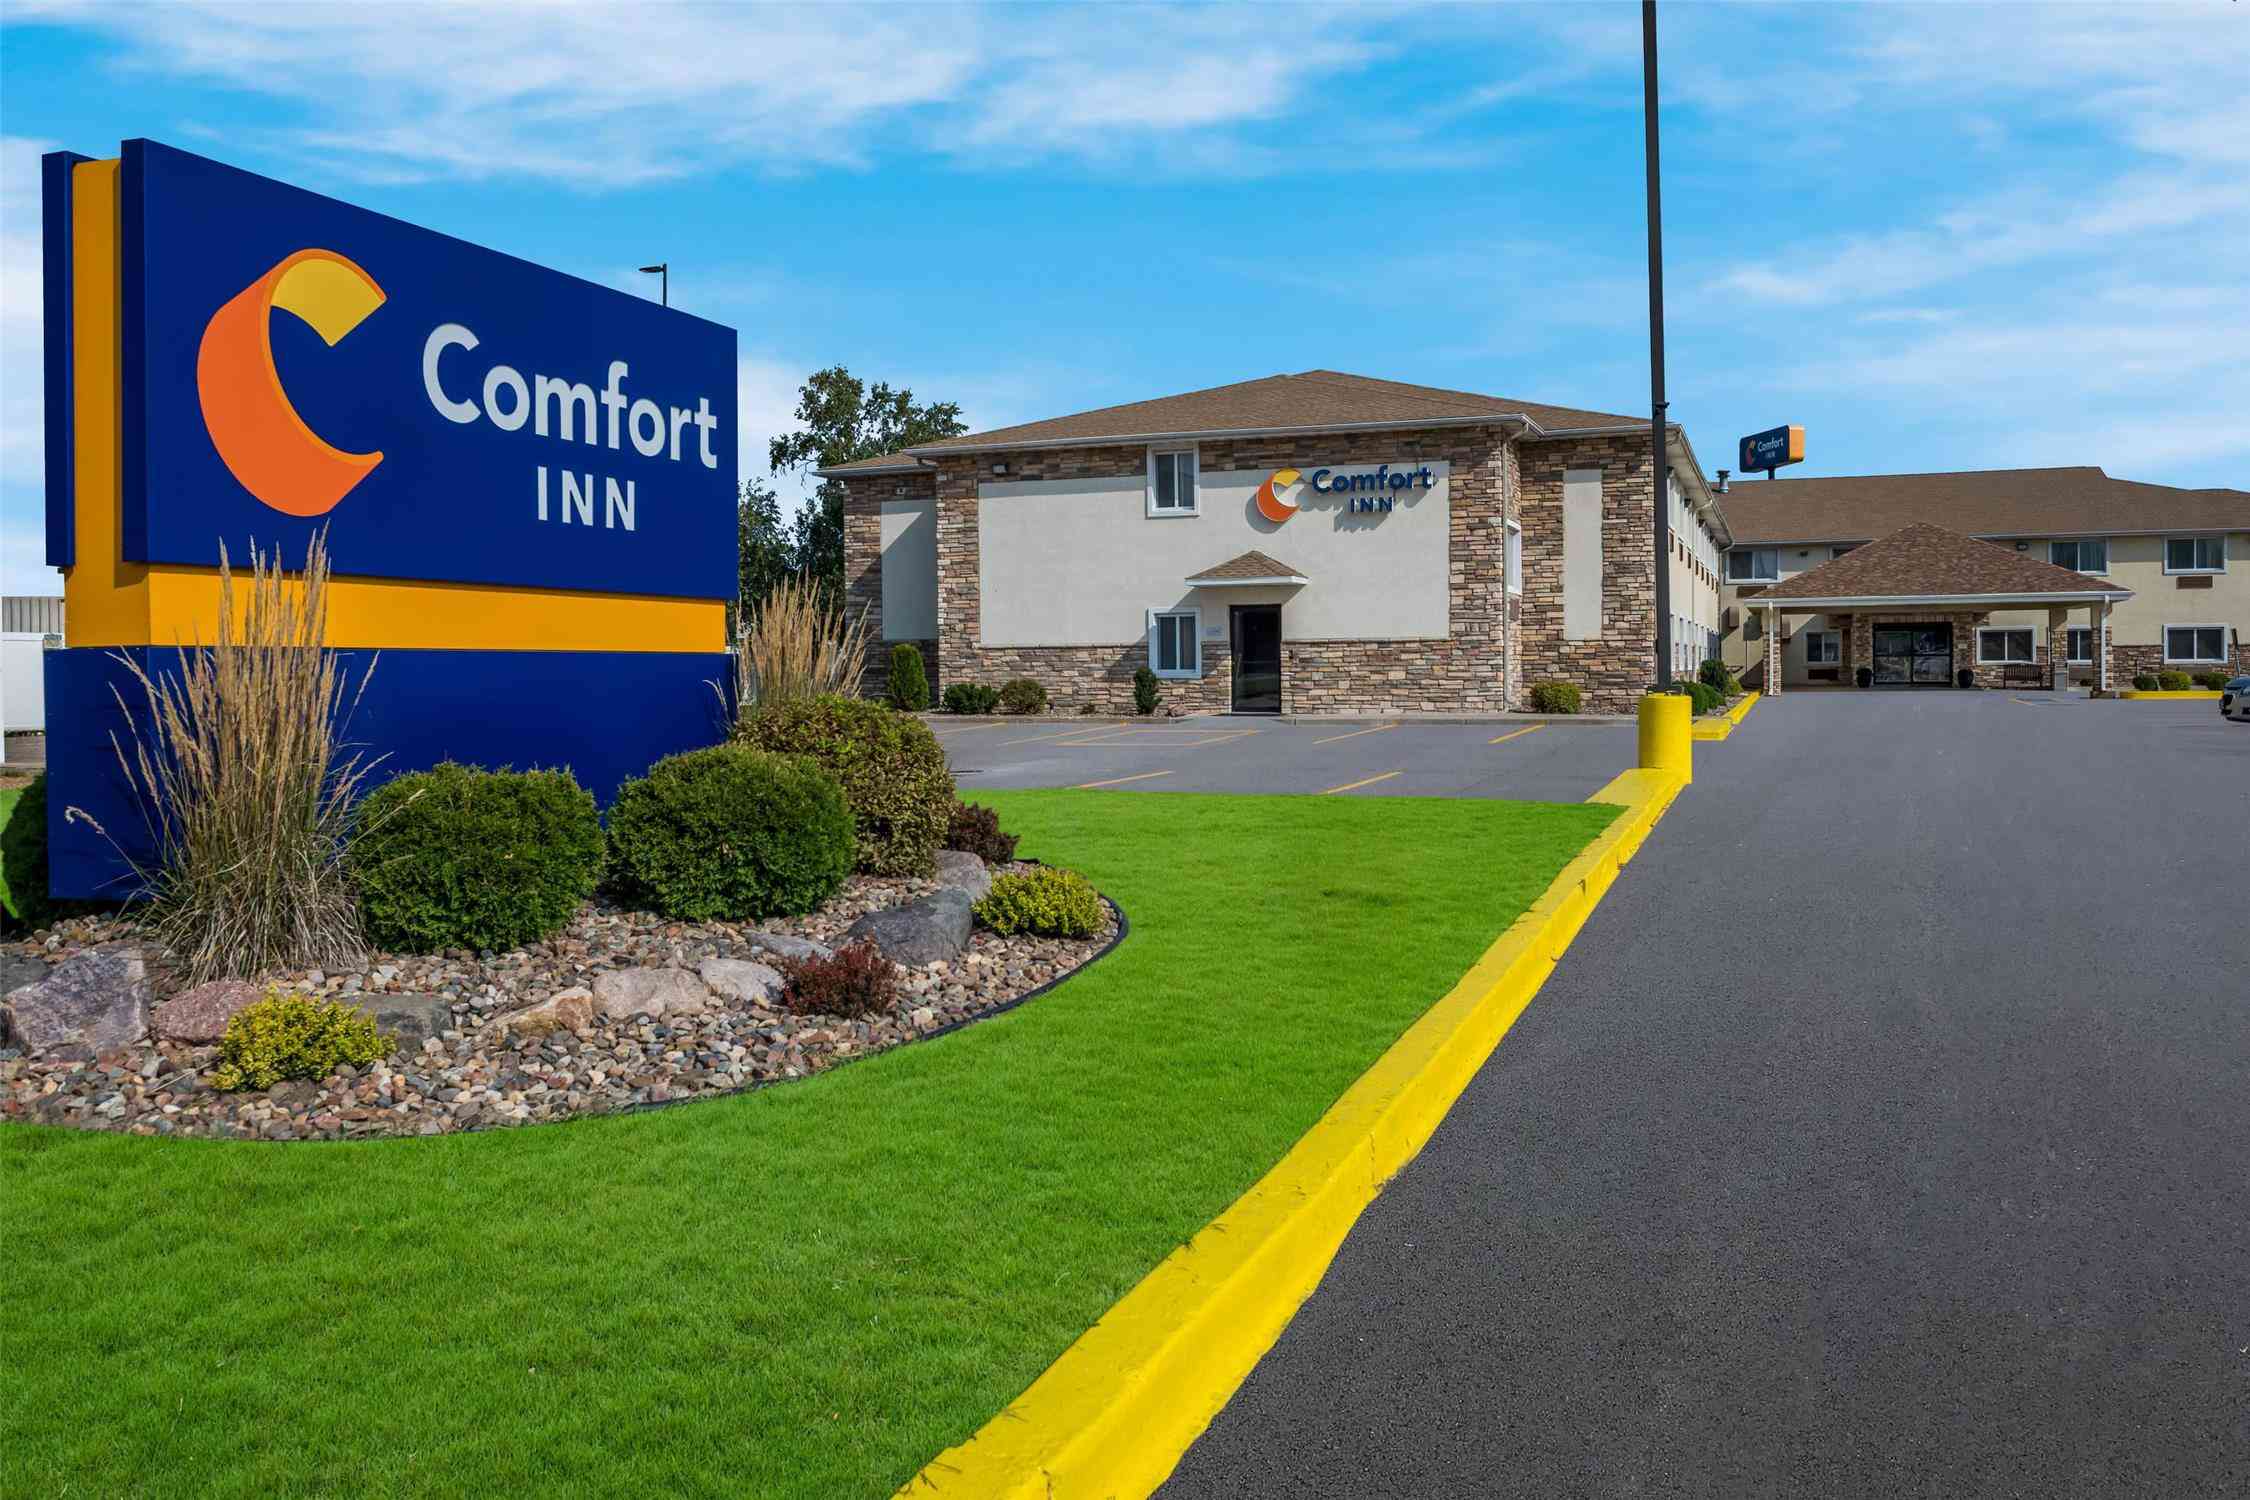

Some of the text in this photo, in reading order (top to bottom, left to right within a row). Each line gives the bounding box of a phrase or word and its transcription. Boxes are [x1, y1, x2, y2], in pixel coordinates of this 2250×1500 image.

[423, 323, 717, 469] Comfort
[537, 466, 635, 531] INN
[1312, 464, 1433, 493] Comfort
[1350, 497, 1393, 512] INN
